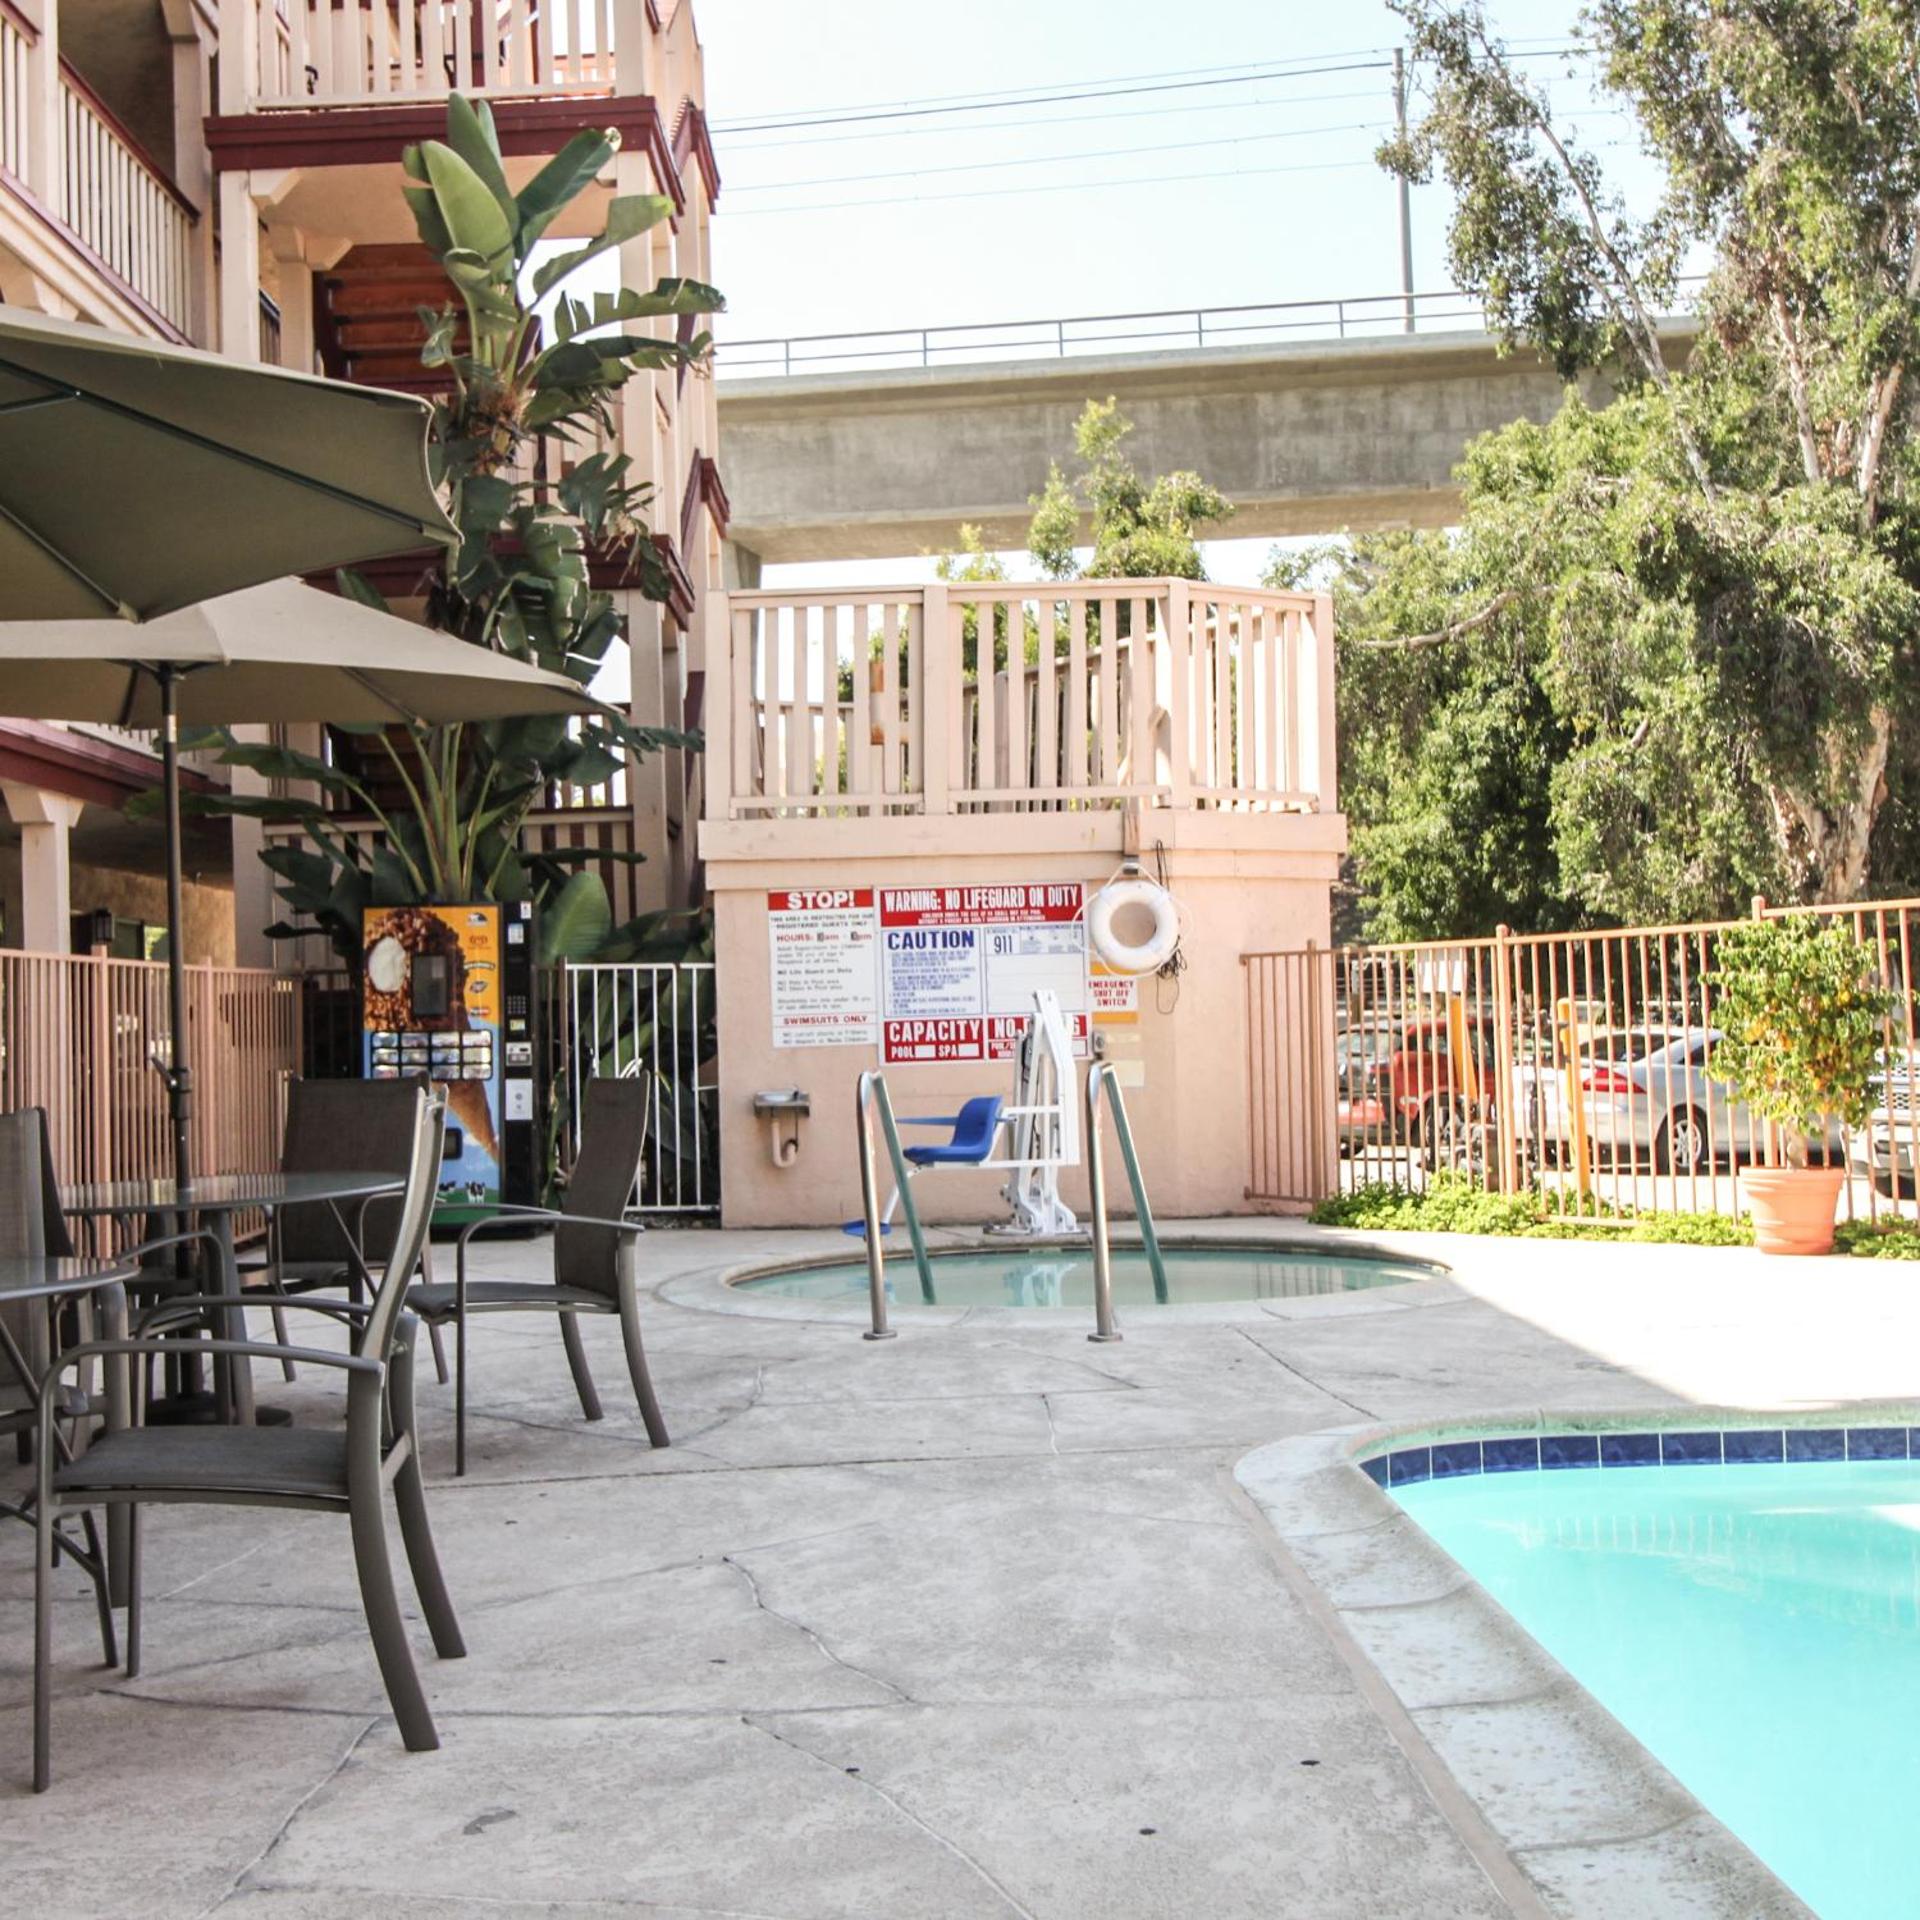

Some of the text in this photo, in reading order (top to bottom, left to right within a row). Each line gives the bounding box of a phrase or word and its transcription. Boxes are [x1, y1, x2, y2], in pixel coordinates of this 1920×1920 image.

[787, 891, 855, 909] STOP!
[884, 886, 1078, 913] WARNING: NO LIFEGUARD ON DUTY
[888, 930, 974, 950] CAUTION
[994, 935, 1012, 953] 911
[1116, 989, 1129, 997] OFF
[784, 1015, 867, 1025] SWIMSUITS ONLY
[994, 1018, 1016, 1039] NO
[889, 1020, 980, 1042] CAPACITY
[891, 1044, 958, 1058] POOL SPA
